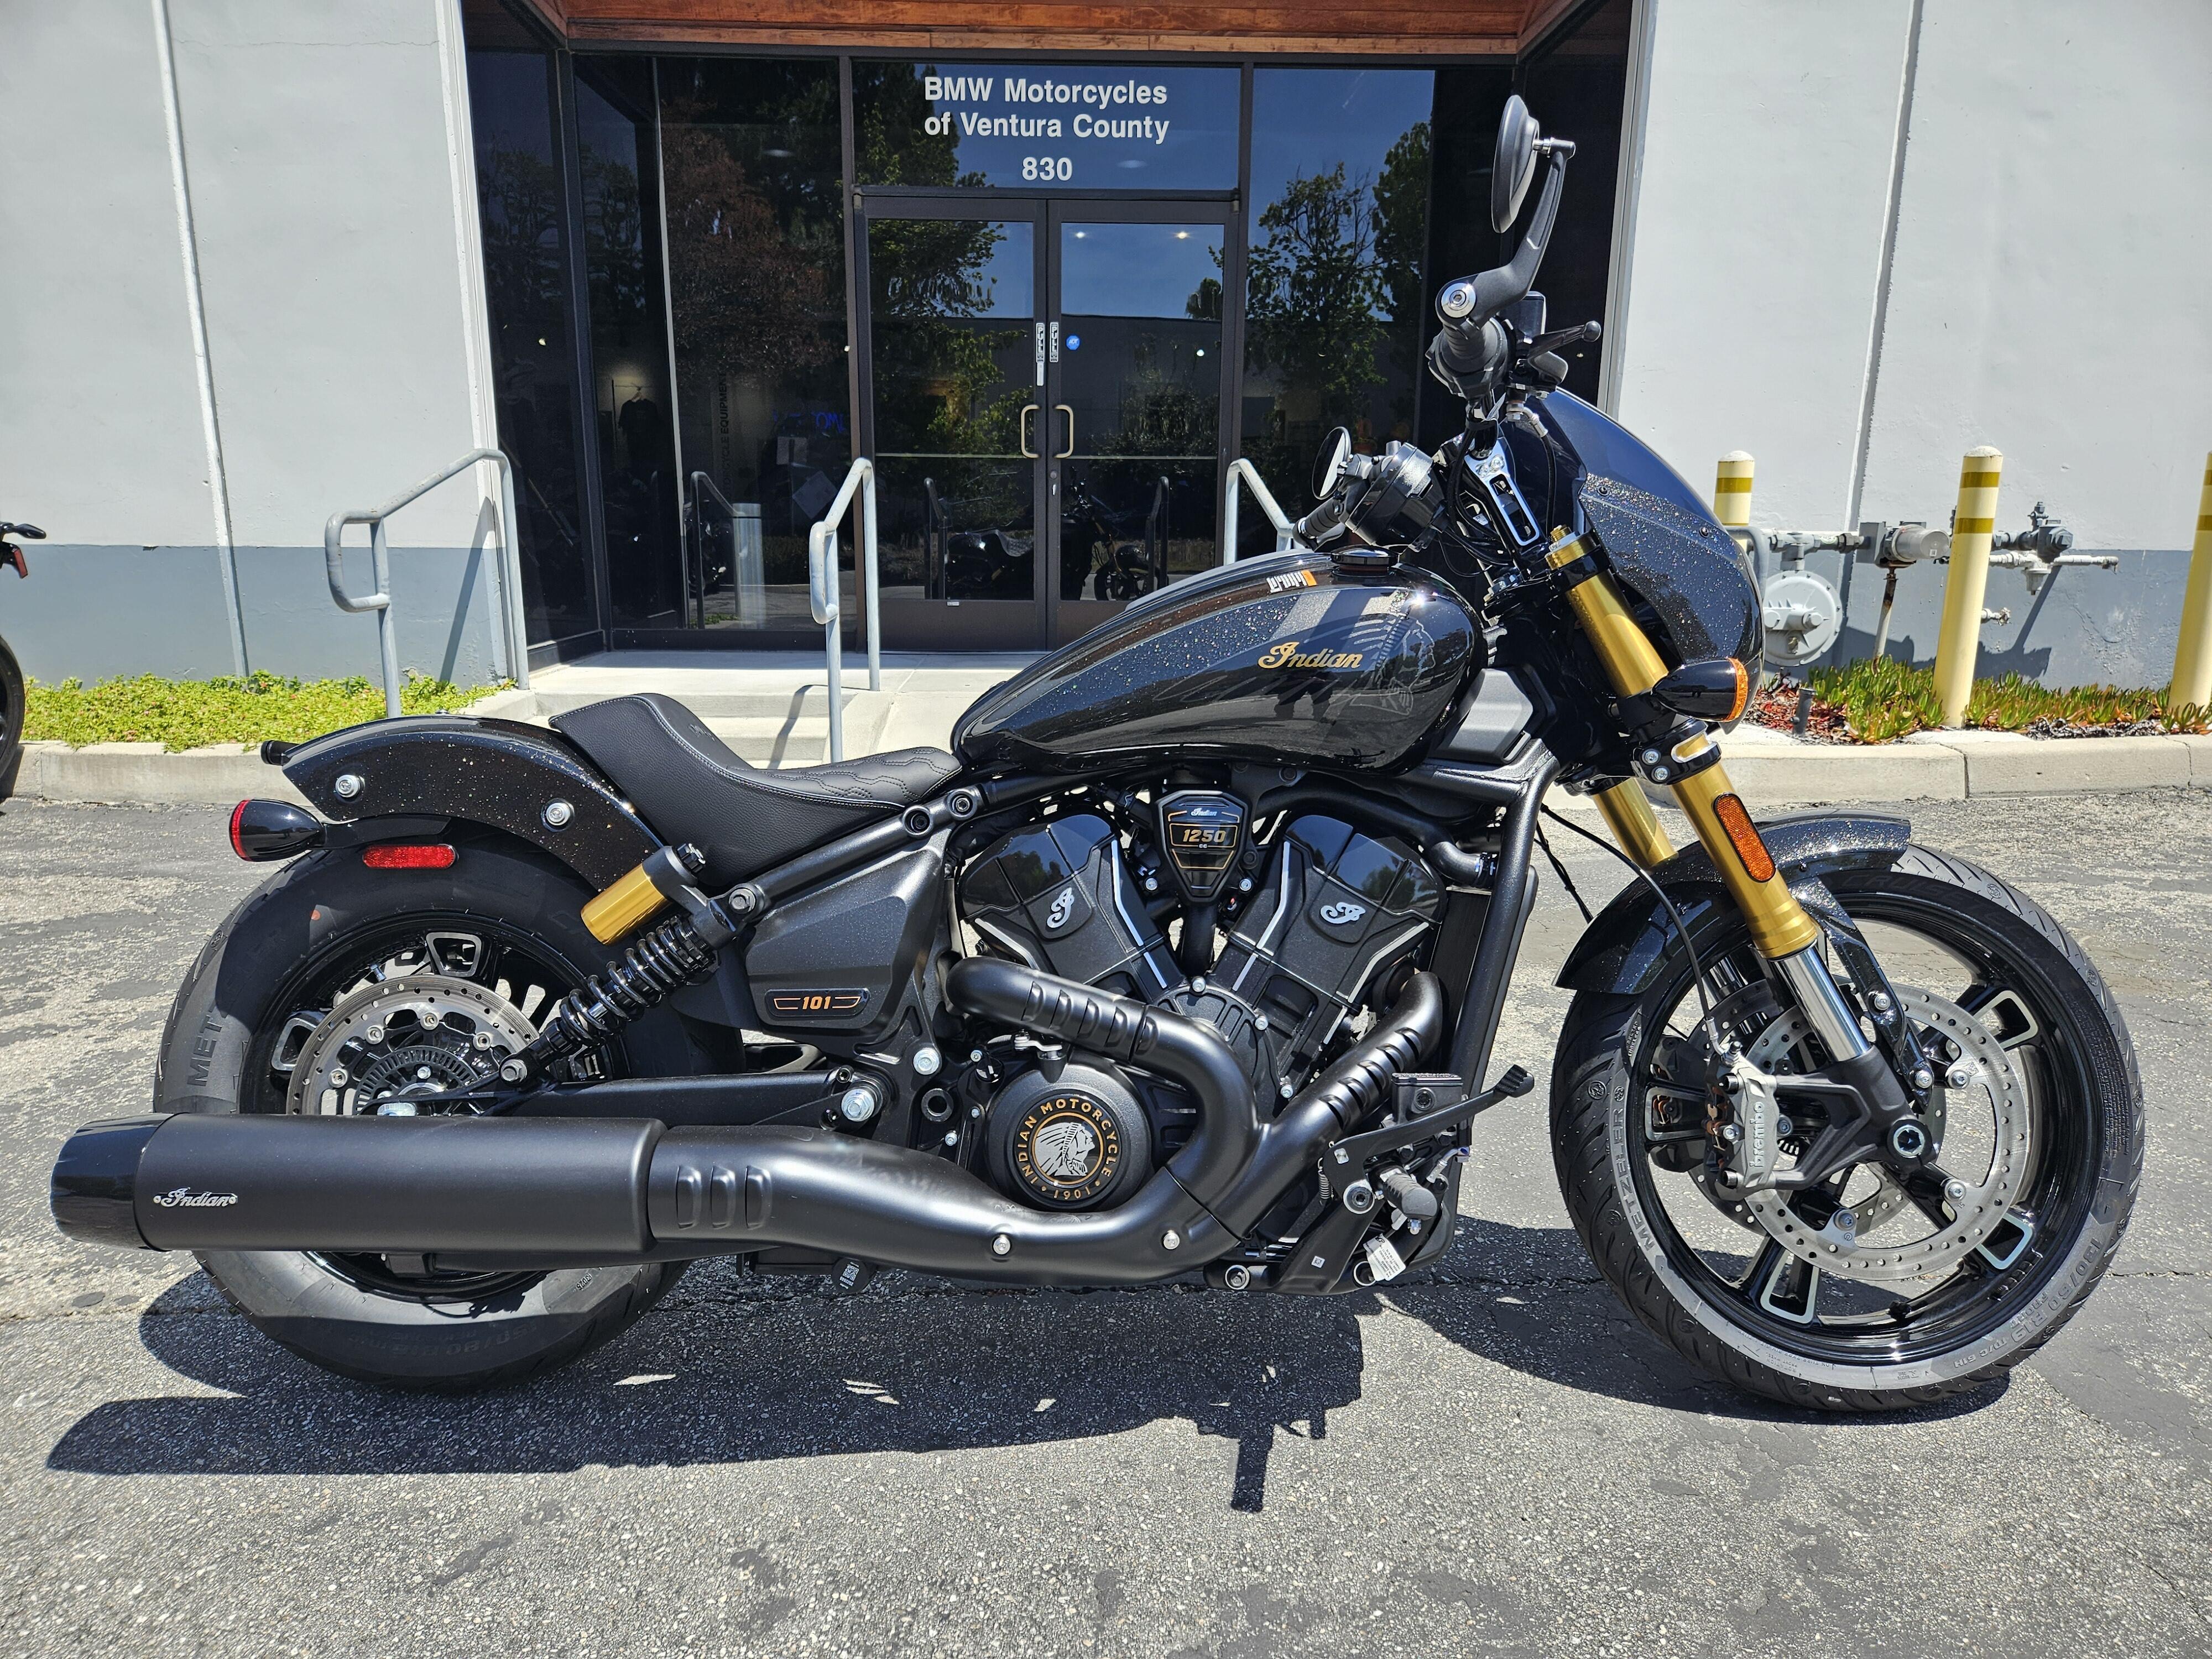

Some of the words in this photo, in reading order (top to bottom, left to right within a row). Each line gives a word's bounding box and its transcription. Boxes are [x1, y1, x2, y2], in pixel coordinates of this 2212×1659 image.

[925, 77, 993, 102] BMW
[1004, 79, 1168, 109] Motorcycles
[925, 112, 952, 135] of
[960, 113, 1062, 138] Ventura
[1073, 113, 1170, 145] County
[1021, 156, 1073, 181] 830
[1258, 641, 1363, 669] Indian
[1190, 807, 1218, 817] Indian
[1182, 829, 1227, 843] 1250
[802, 996, 831, 1010] 101
[1018, 1115, 1038, 1184] INDIAN
[1040, 1098, 1118, 1177] MOTORCYCLE
[1750, 1101, 1765, 1167] brembo
[1611, 1107, 1656, 1252] METZELER
[160, 1187, 229, 1207] Indian
[1053, 1186, 1091, 1200] 1901
